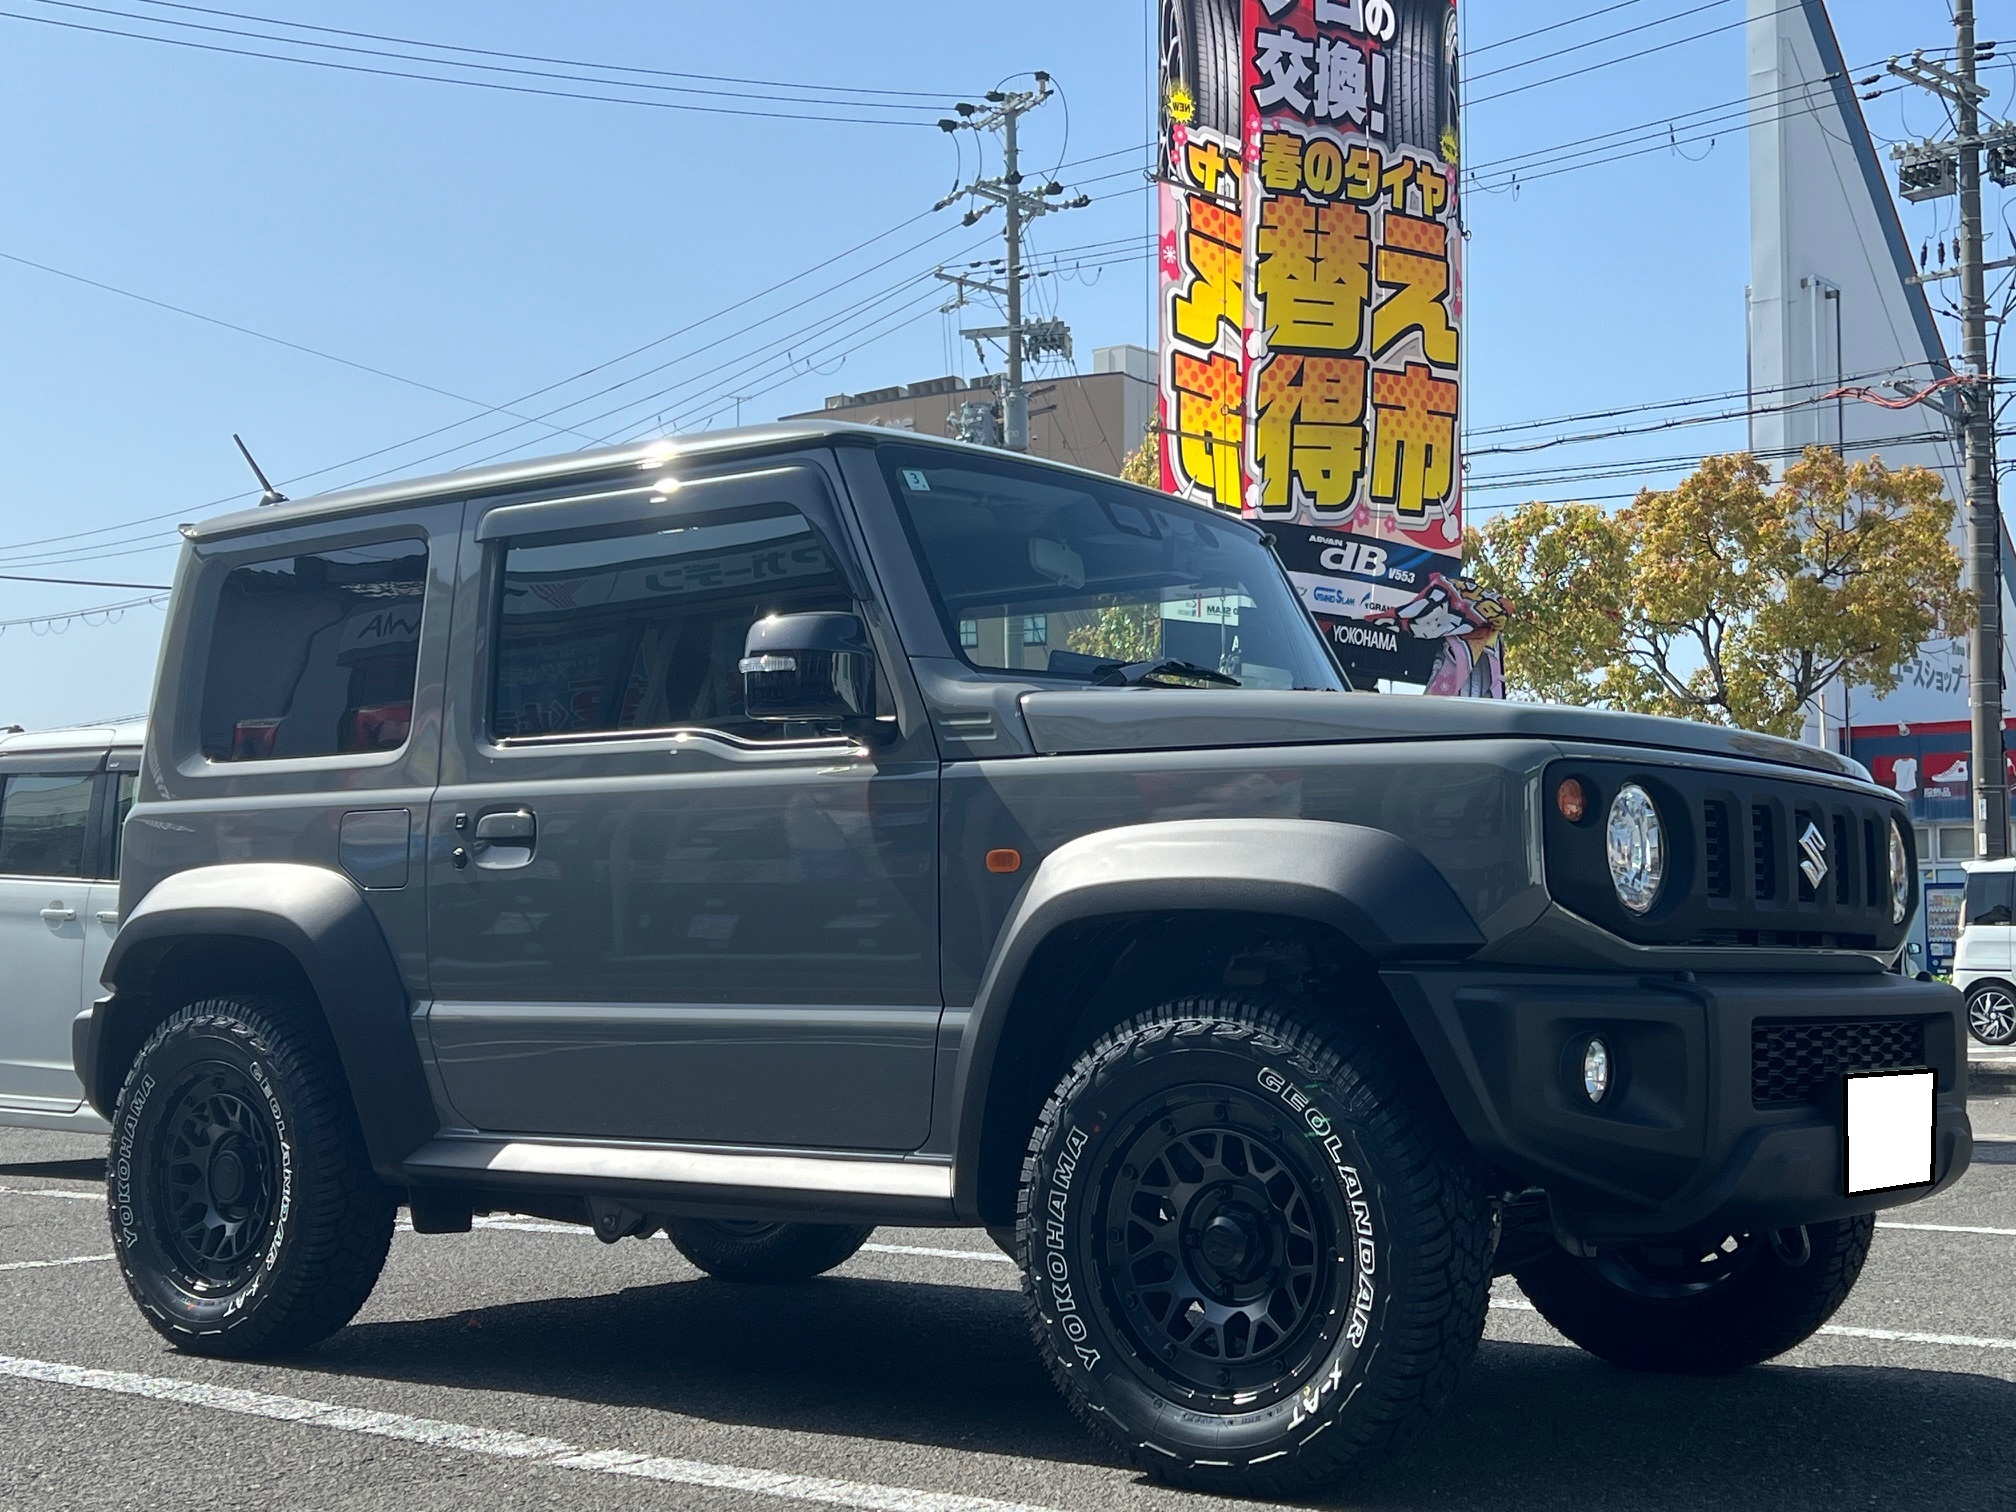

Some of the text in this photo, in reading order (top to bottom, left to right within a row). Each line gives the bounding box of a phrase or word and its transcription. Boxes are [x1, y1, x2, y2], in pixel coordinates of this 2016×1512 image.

[1254, 28, 1386, 134] 交換!
[1261, 132, 1446, 217] 春のタイヤ
[1257, 195, 1458, 366] 替え
[1309, 534, 1343, 547] ADVAN
[1320, 541, 1387, 577] dB
[1388, 567, 1415, 584] V553
[1333, 625, 1398, 652] YOKOHAMA
[118, 1074, 155, 1248] YOKOHAMA
[1257, 1066, 1376, 1348] GEOLANDAR
[1046, 1126, 1100, 1371] YOKOHAMA
